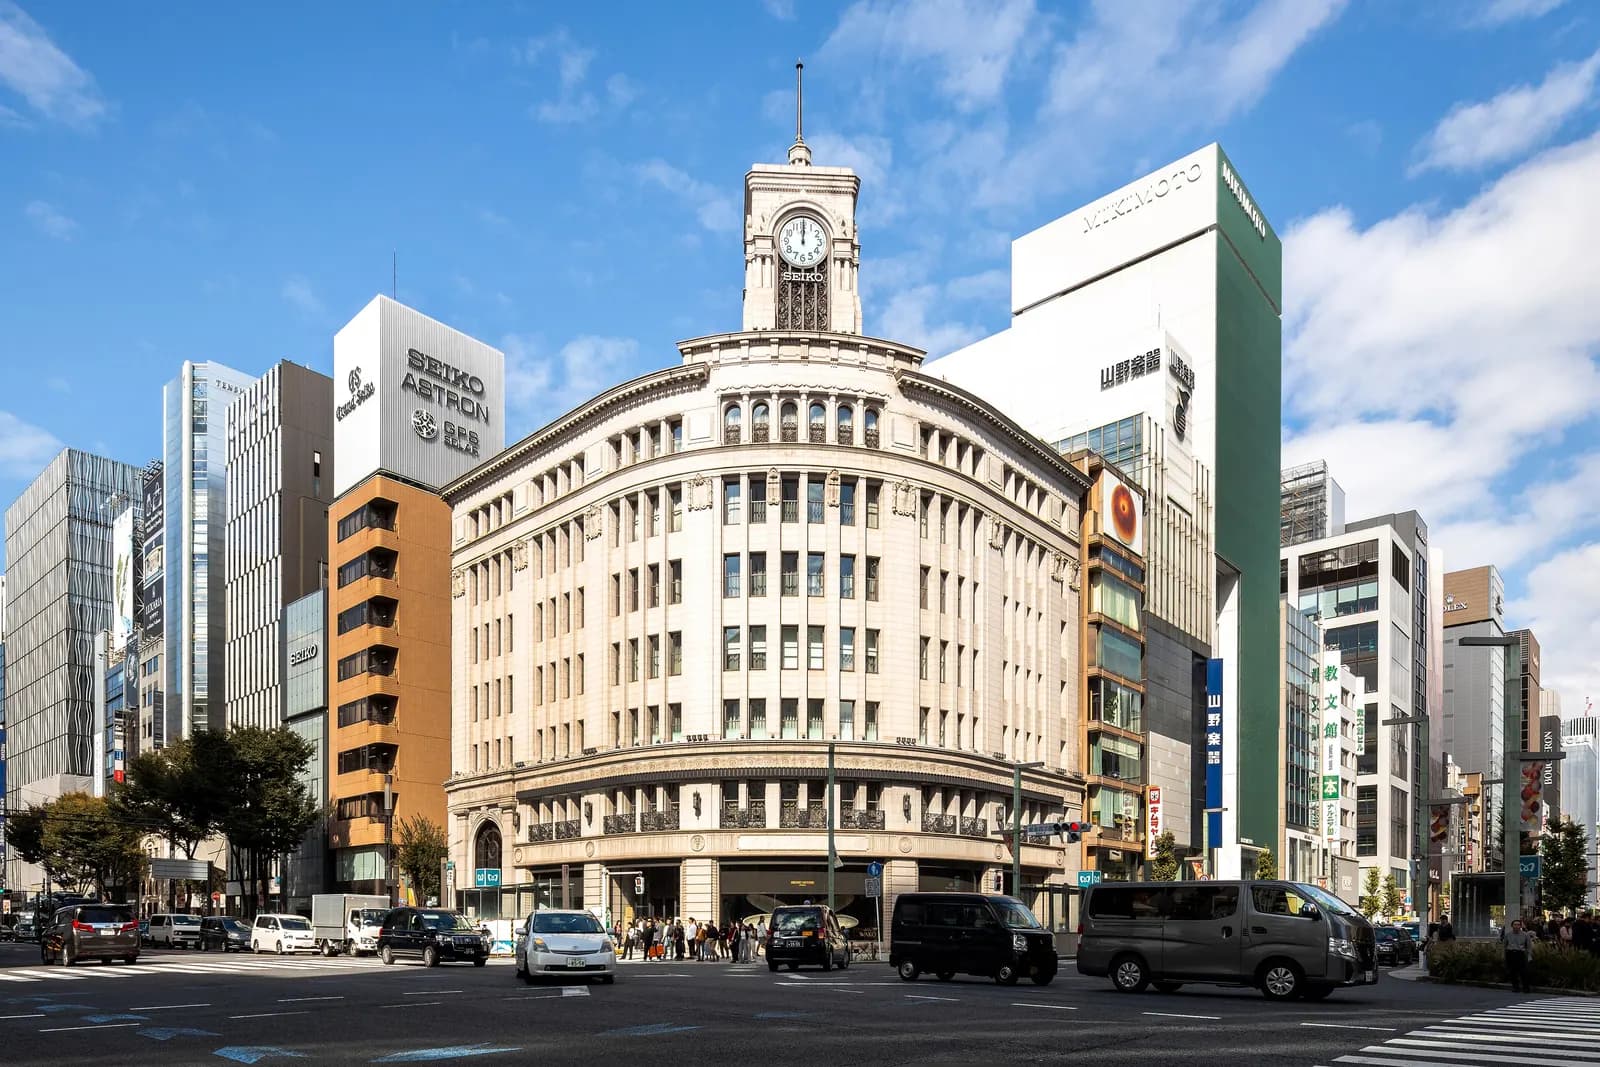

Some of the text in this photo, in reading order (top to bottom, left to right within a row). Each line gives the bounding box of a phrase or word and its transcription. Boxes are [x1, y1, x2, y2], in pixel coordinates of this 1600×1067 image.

[1083, 163, 1203, 233] MIKIMOTO
[1223, 162, 1266, 239] MIKIMOTO
[814, 230, 819, 238] 2
[808, 252, 813, 260] 5
[783, 271, 824, 282] SEIKO
[408, 348, 485, 396] SEIKO
[336, 381, 376, 422] Grand Seiko
[401, 371, 489, 424] ASTRON
[443, 420, 479, 446] GPS
[289, 644, 319, 667] SEIKO
[1323, 664, 1339, 739] 教文館
[1207, 694, 1221, 765] 山野楽器
[1324, 780, 1337, 796] 本
[1150, 806, 1160, 836] キムラヤ
